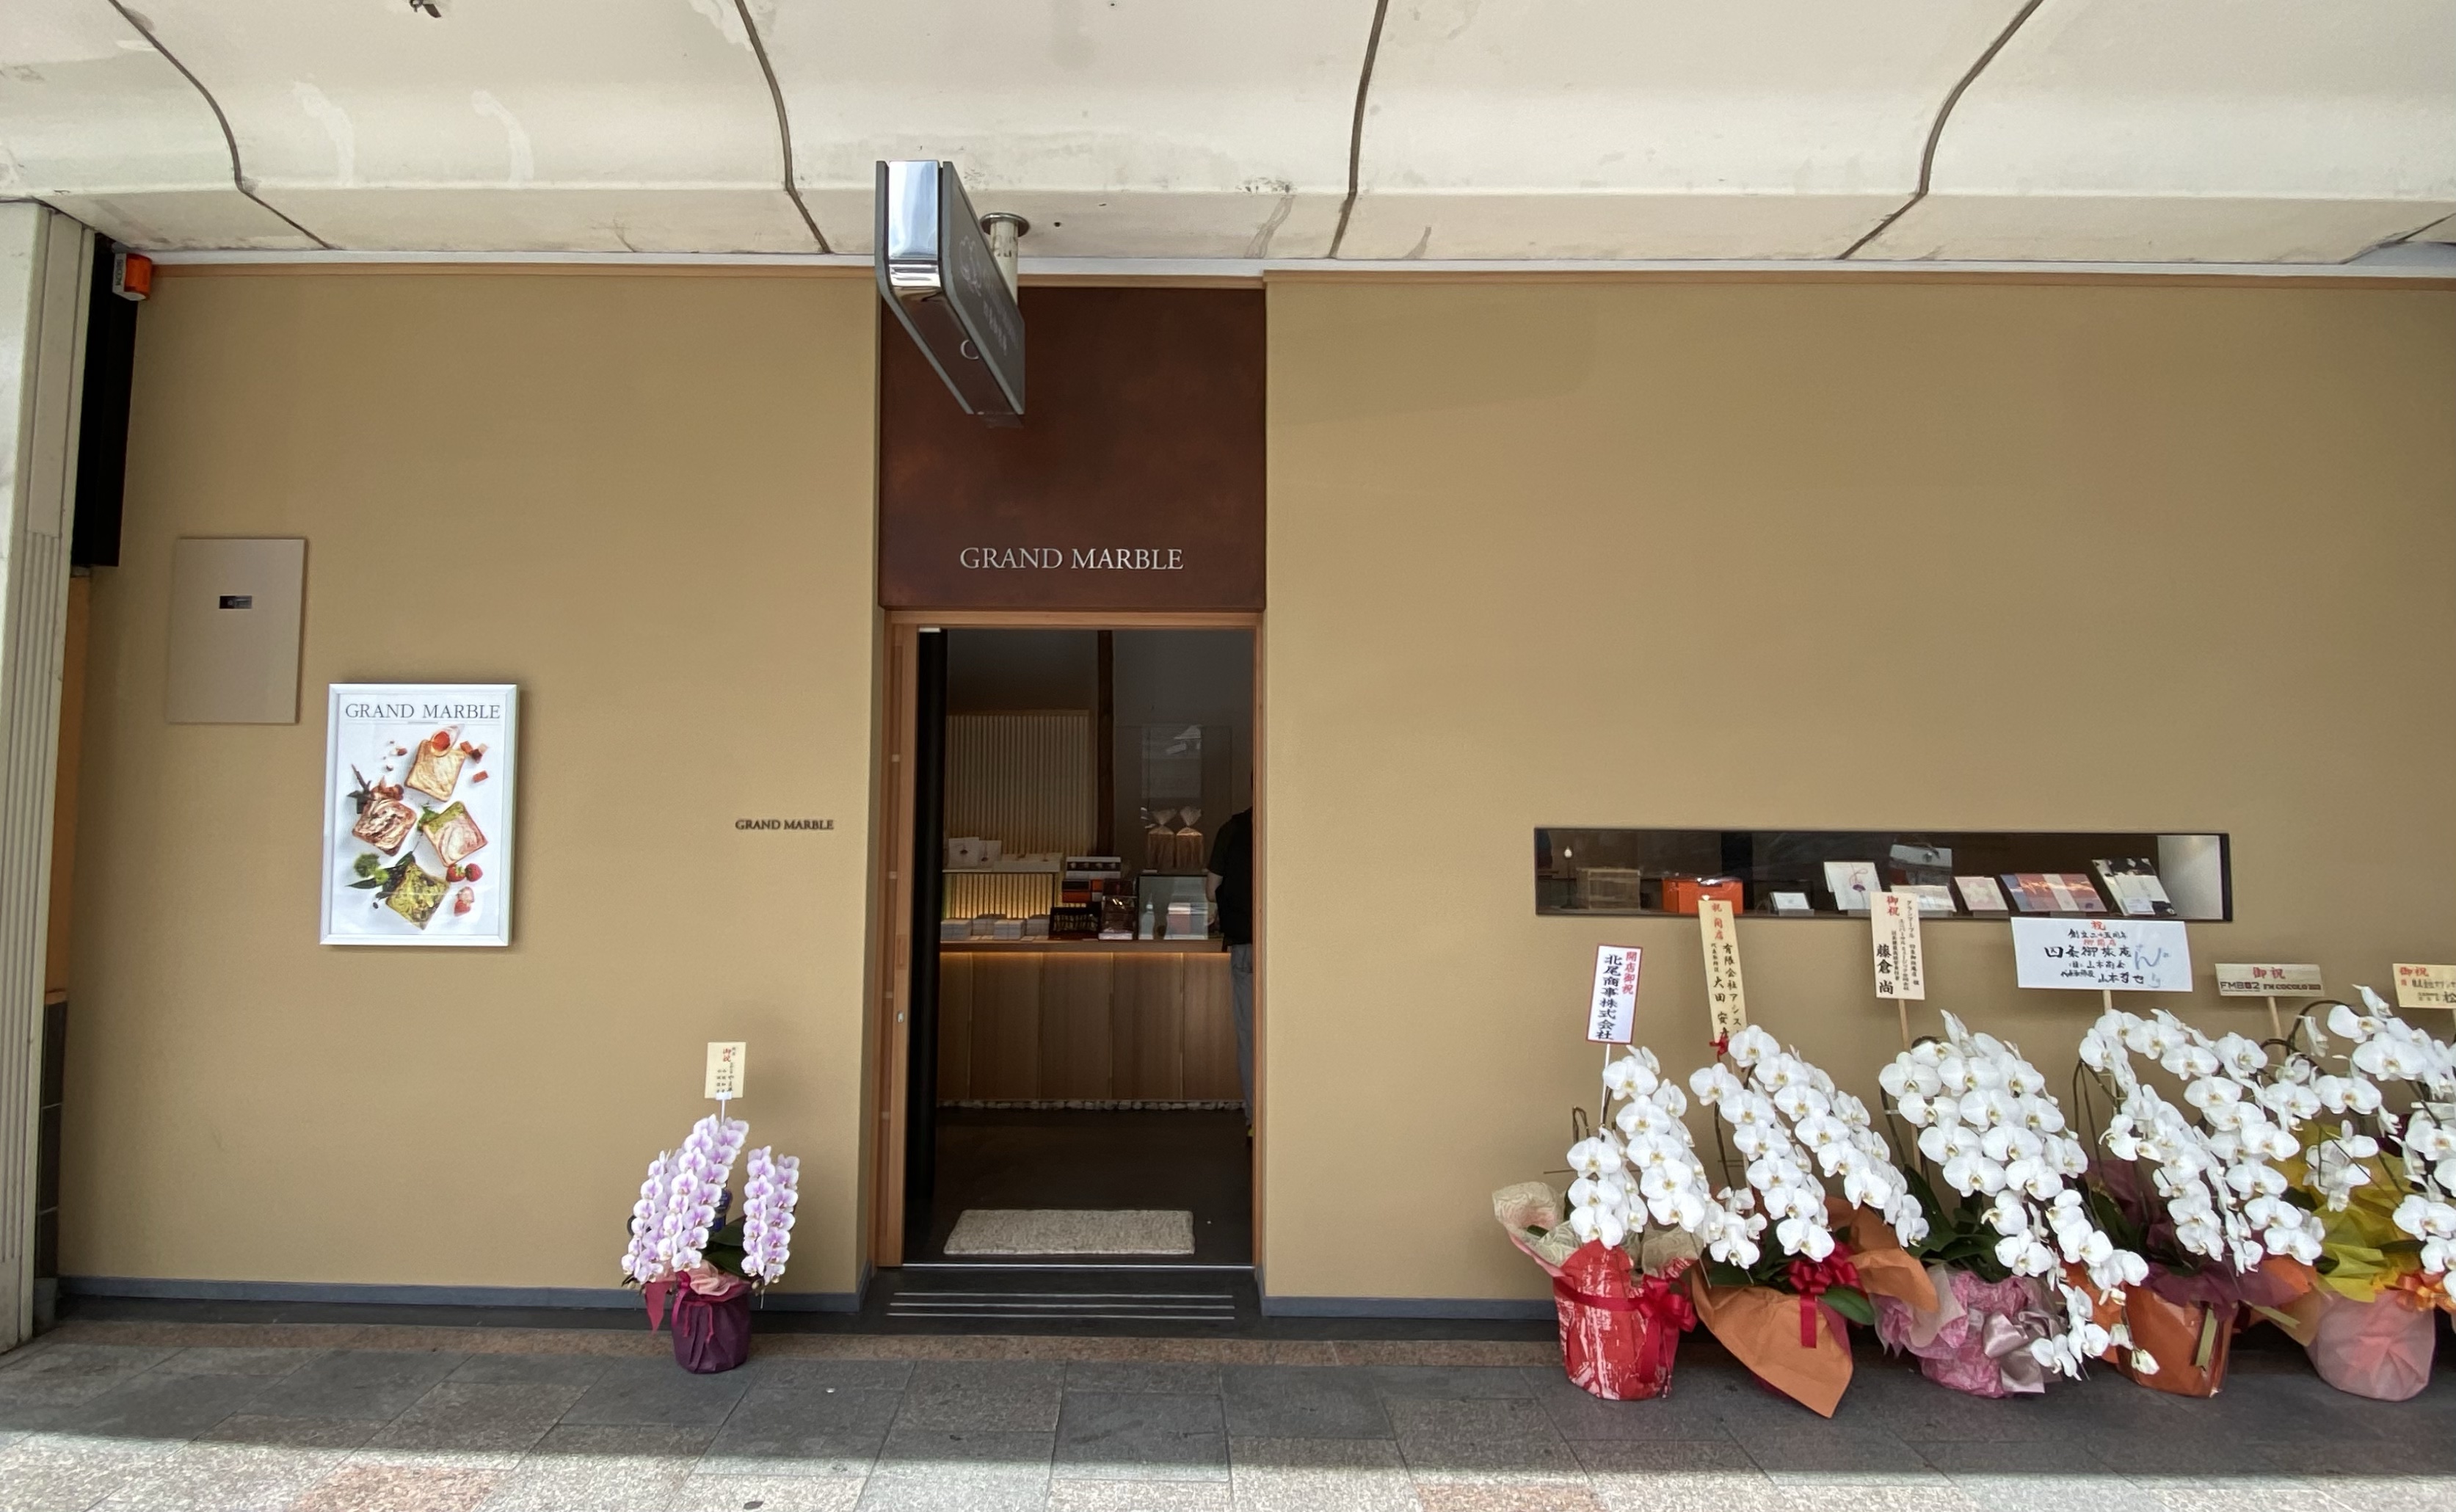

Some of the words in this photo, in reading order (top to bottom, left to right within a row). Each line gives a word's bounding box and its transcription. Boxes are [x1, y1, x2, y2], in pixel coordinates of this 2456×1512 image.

[959, 547, 1063, 570] GRAND
[1071, 548, 1184, 570] MARBLE
[345, 703, 415, 719] GRAND
[422, 703, 501, 719] MARBLE
[735, 819, 781, 830] GRAND
[783, 819, 835, 830] MARBLE
[1886, 895, 1900, 917] 御祝
[2090, 920, 2107, 931] 祝
[1621, 951, 1638, 995] 開店御祝
[2253, 966, 2286, 979] 御祝
[1595, 953, 1624, 1042] 北尾商事株式会社
[1723, 943, 1741, 1033] 有限会社アシス
